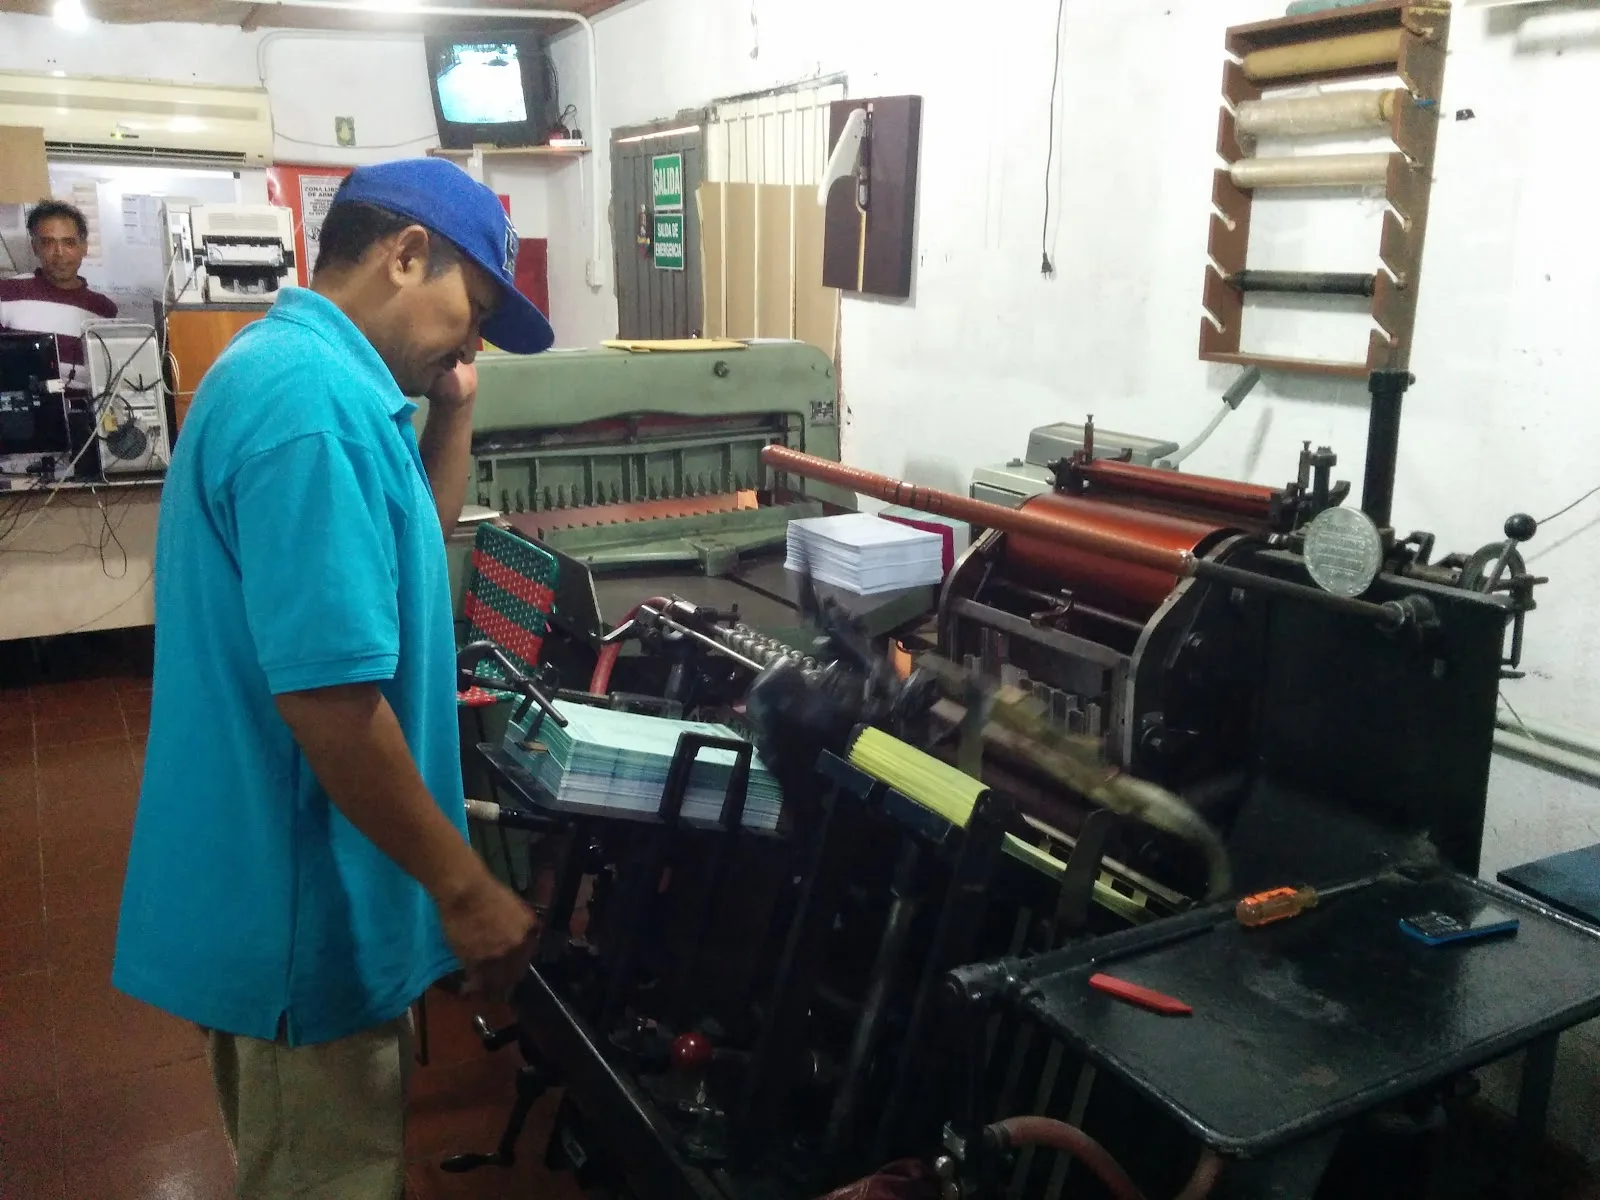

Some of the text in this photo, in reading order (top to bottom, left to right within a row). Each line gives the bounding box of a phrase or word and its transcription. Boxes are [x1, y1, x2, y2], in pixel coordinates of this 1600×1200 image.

[654, 167, 680, 196] SALIDA
[657, 222, 679, 238] SALIDA DE
[655, 242, 682, 258] EMERGENCIA
